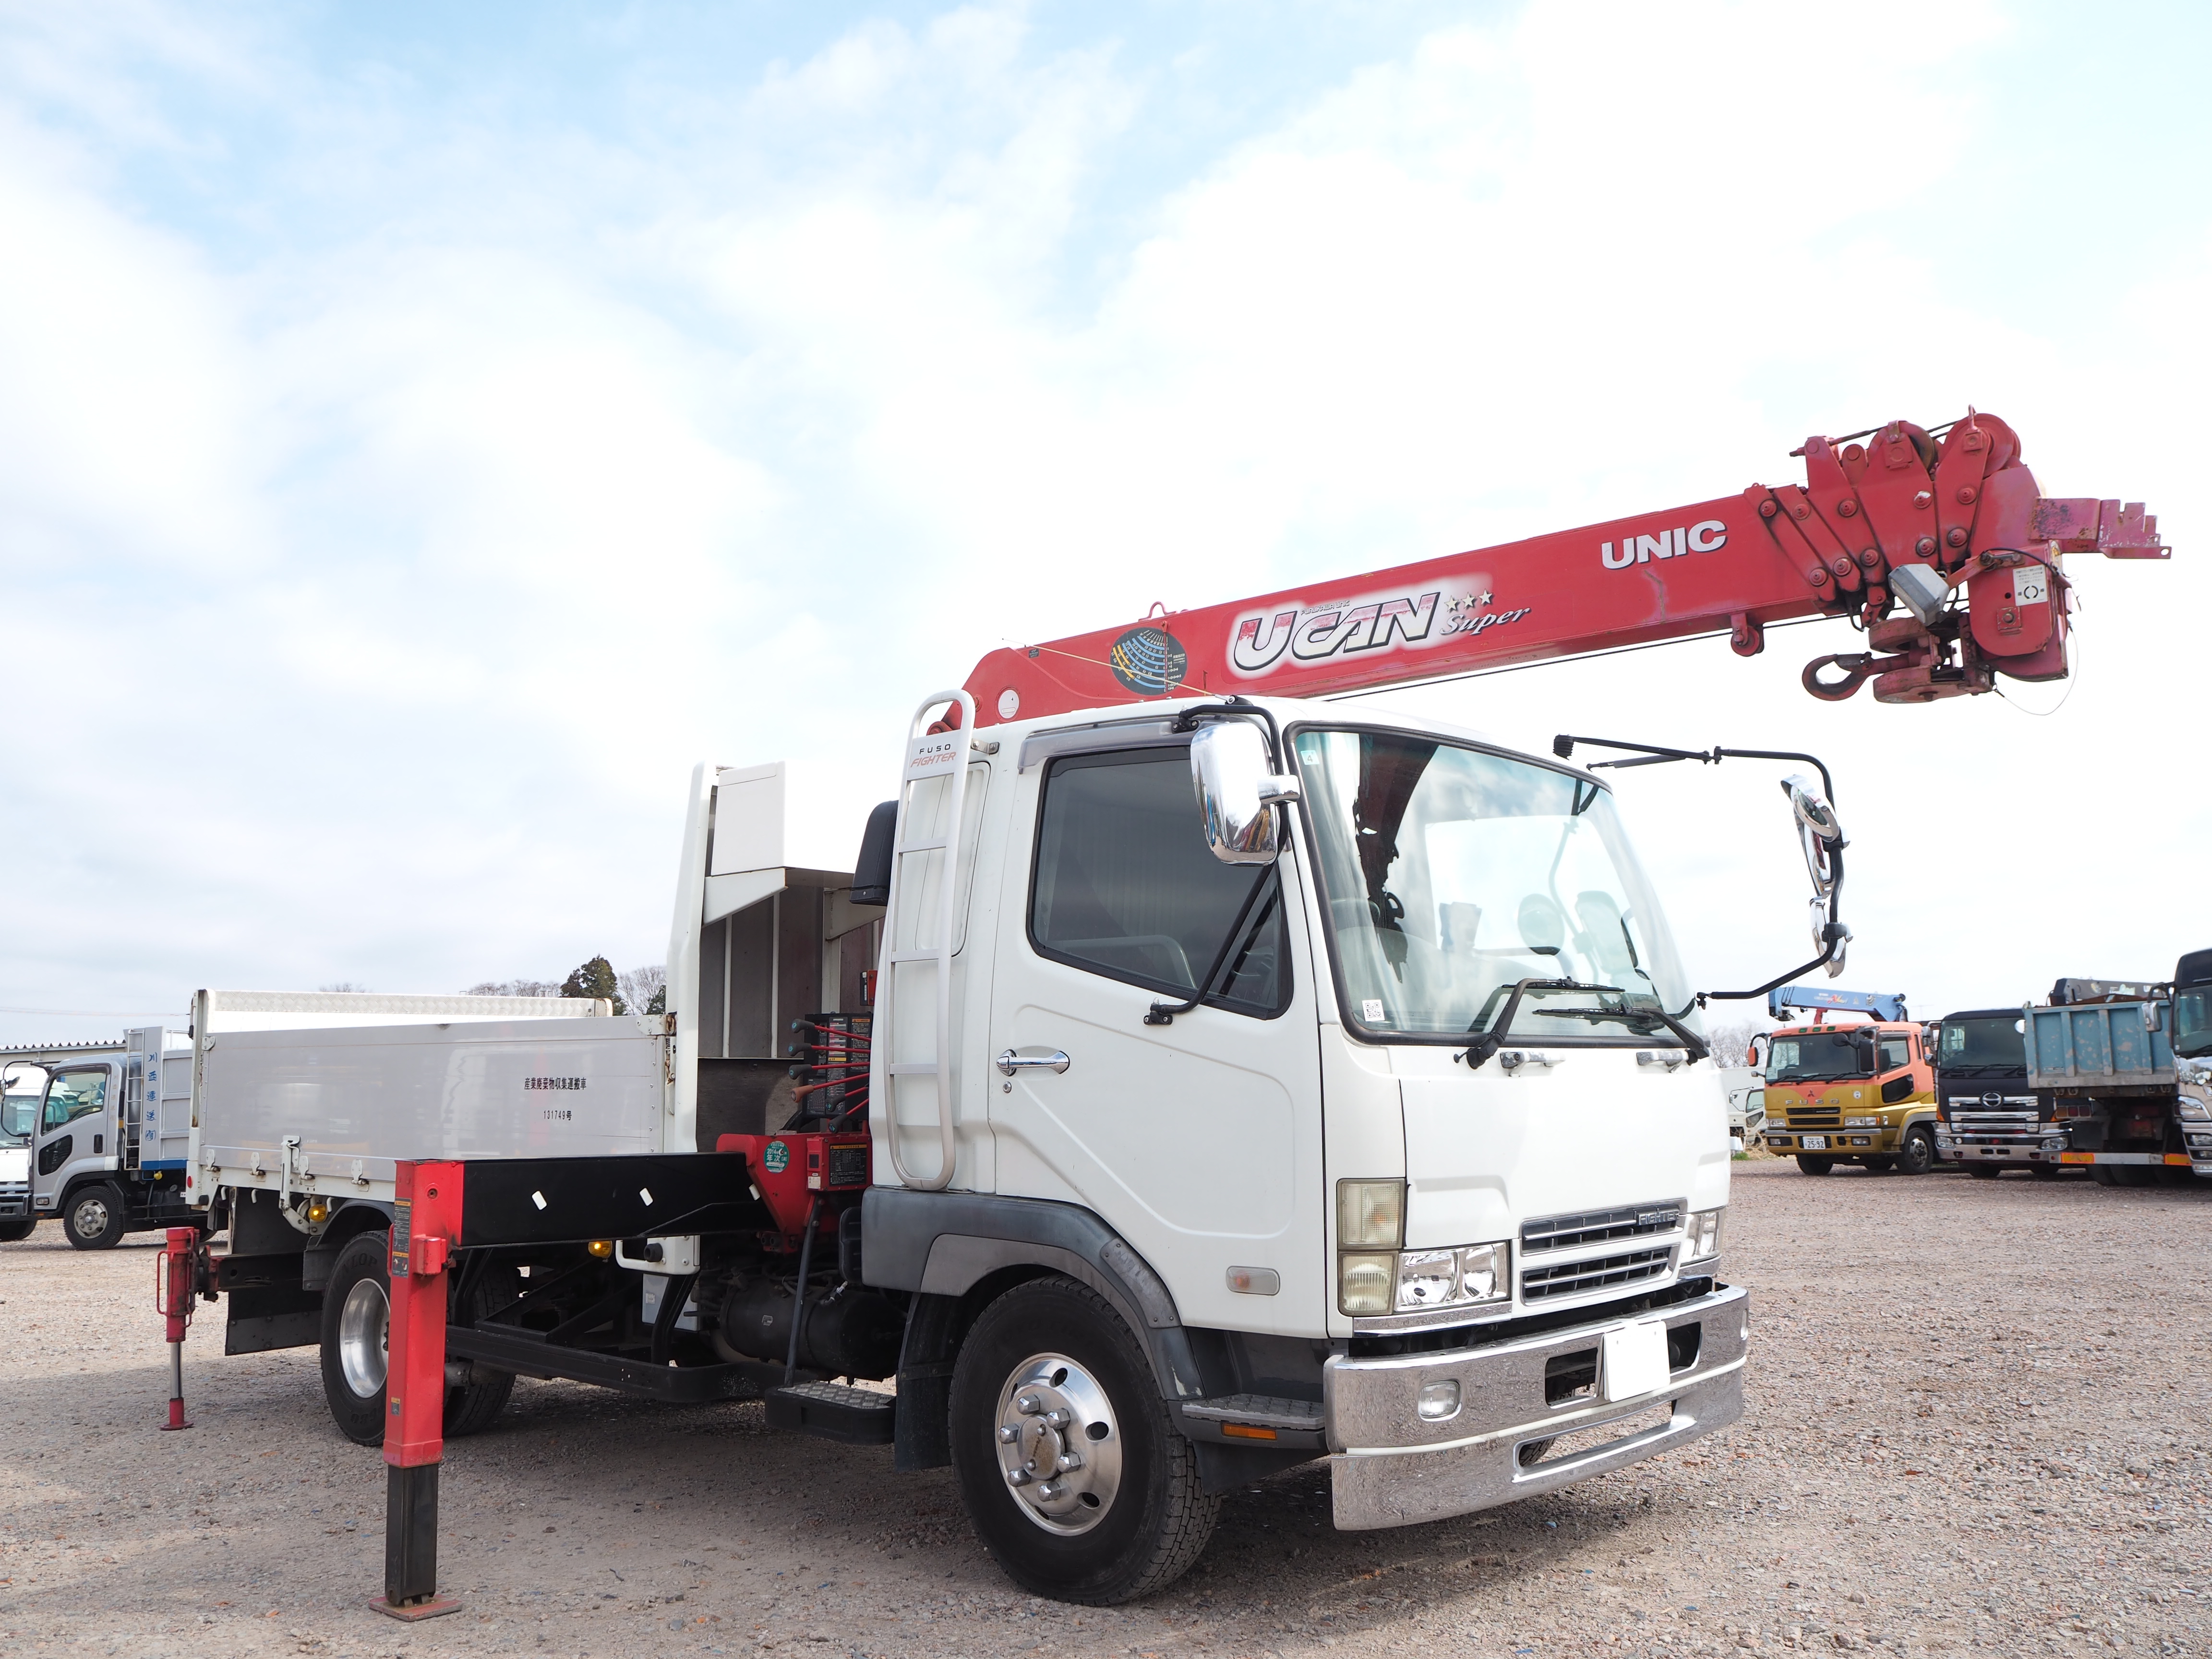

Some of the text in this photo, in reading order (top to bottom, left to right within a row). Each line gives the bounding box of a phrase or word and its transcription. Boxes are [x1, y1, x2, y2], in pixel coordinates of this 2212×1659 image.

[1601, 520, 1727, 570] UNIC
[1301, 603, 1334, 615] FURUKAWA
[1439, 607, 1532, 636] Super
[1234, 592, 1441, 671] UCAN
[919, 744, 951, 755] FUSO
[910, 752, 957, 768] FIGHTER
[524, 1077, 587, 1090] 産業廃棄物収集運搬車
[543, 1110, 572, 1120] 131749号
